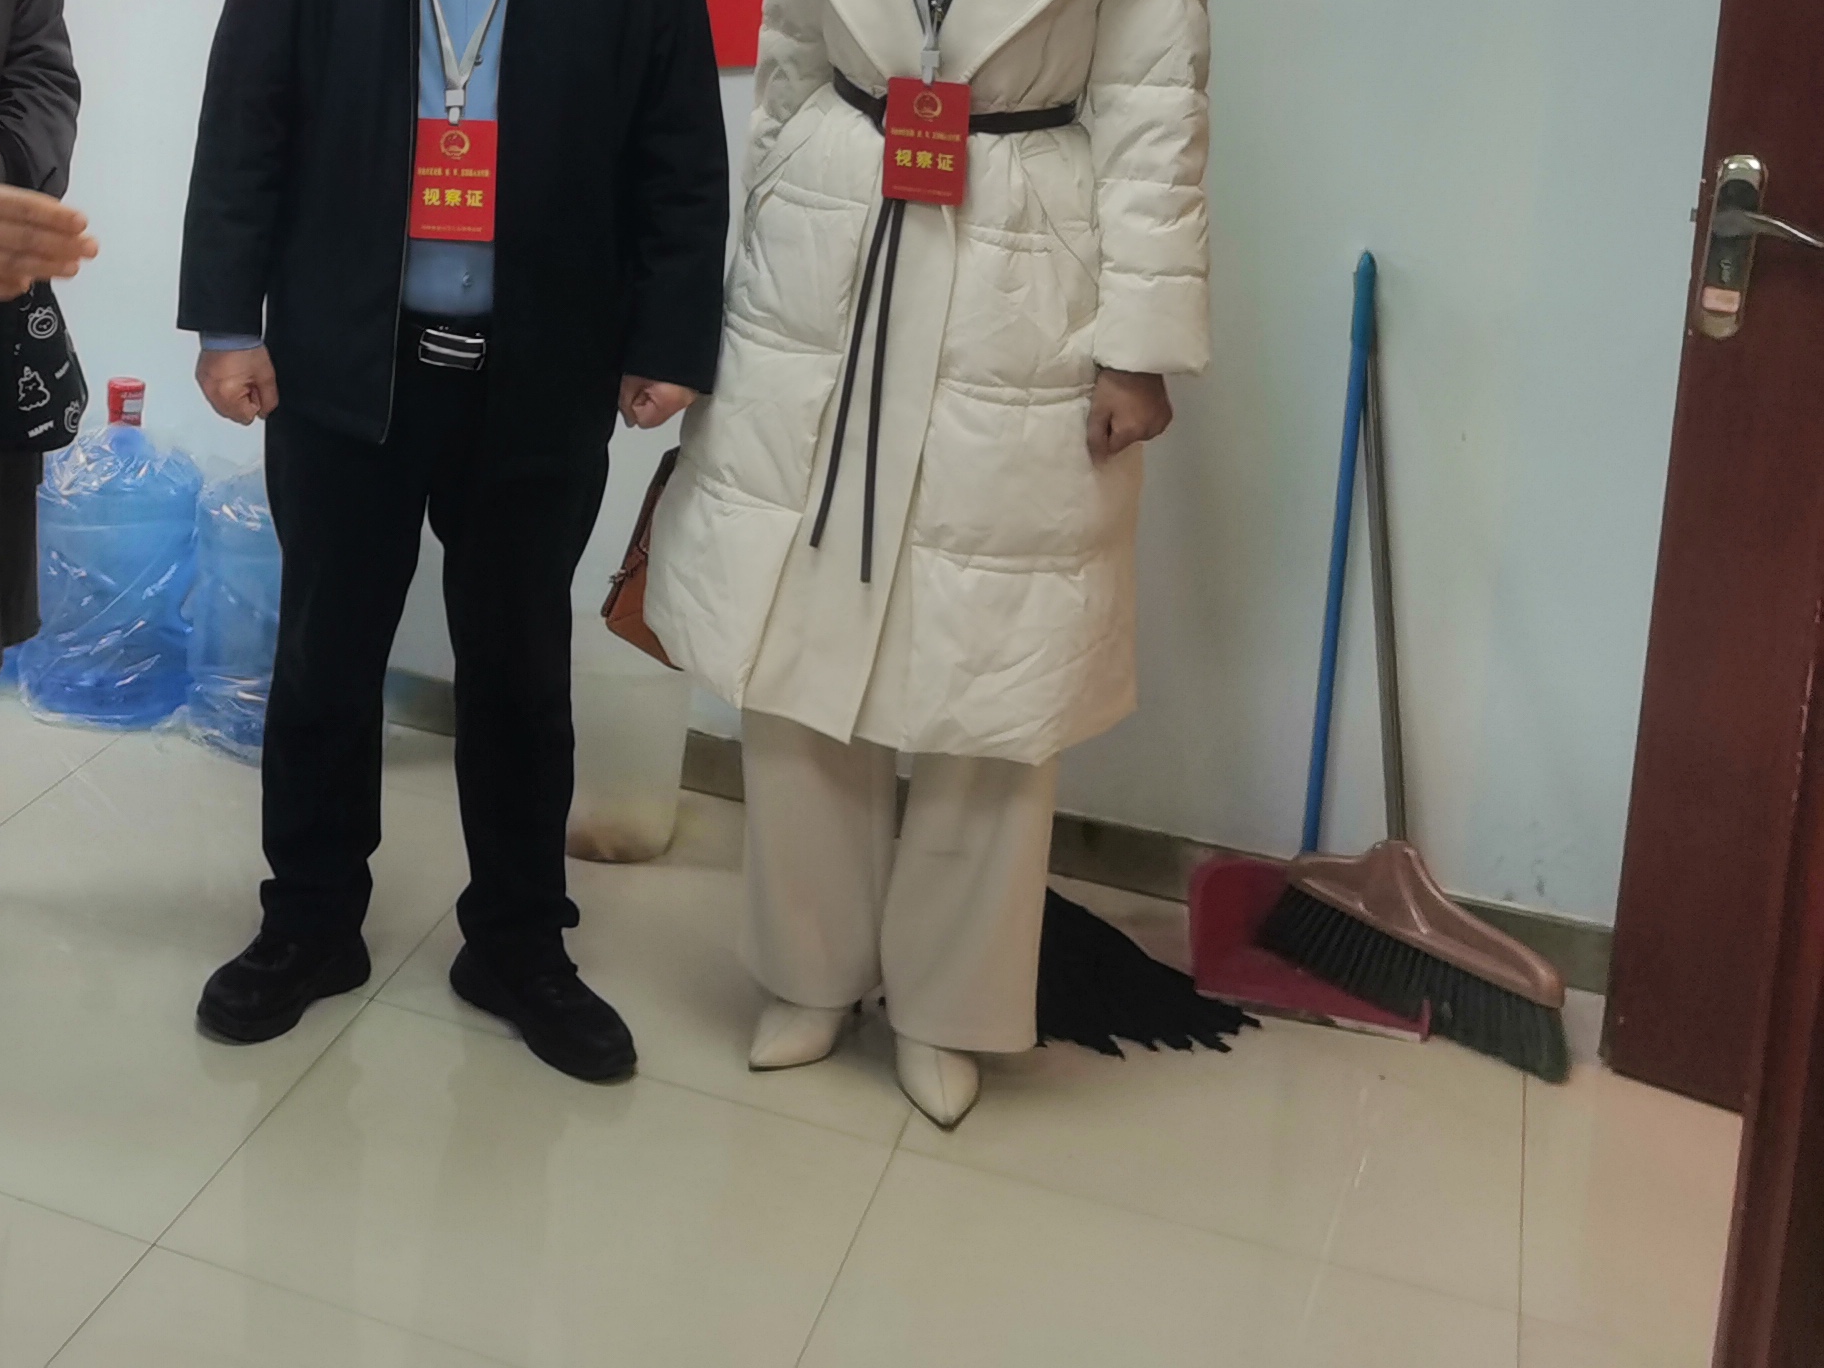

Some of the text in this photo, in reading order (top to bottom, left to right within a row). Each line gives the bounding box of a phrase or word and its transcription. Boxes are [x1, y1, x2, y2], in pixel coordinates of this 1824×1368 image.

[895, 148, 954, 172] 视察证
[423, 188, 483, 208] 视察证
